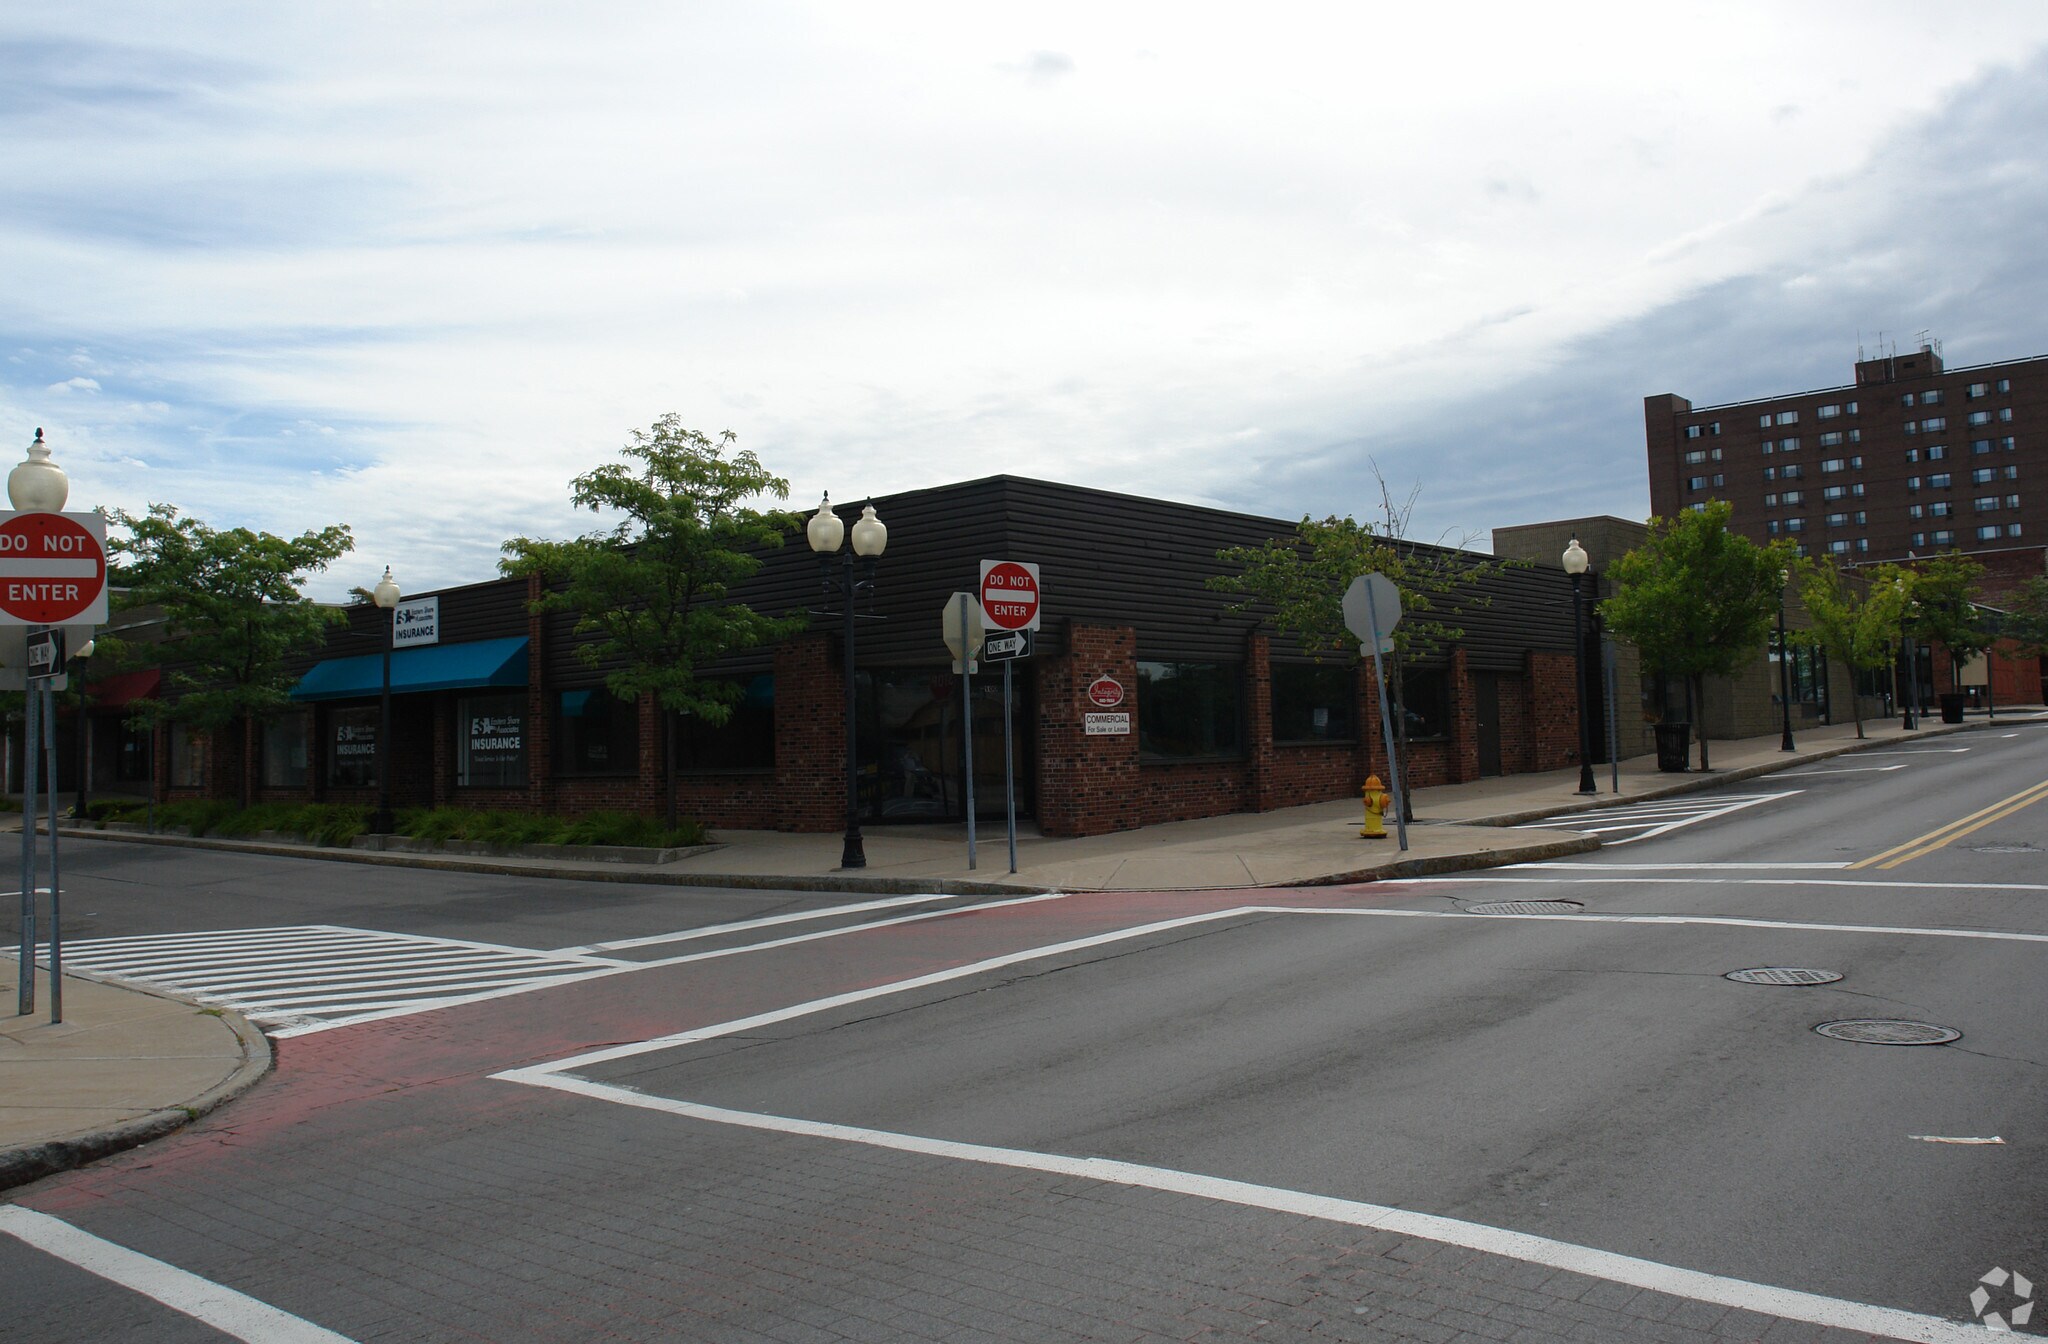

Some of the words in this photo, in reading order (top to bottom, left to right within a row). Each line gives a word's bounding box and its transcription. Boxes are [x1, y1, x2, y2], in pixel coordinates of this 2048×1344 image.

[0, 534, 28, 551] DO
[43, 535, 86, 552] NOT
[990, 574, 1004, 586] DO
[1010, 576, 1030, 587] NOT
[8, 584, 79, 601] ENTER
[994, 604, 1027, 617] ENTER
[396, 625, 434, 640] INSURANCE
[988, 641, 1001, 653] ONE
[1004, 638, 1017, 651] WAY
[29, 647, 39, 664] ONE
[40, 645, 49, 662] WAY
[1086, 714, 1129, 724] COMMERCIAL
[337, 743, 375, 755] INSURANCE
[471, 736, 521, 750] INSURANCE
